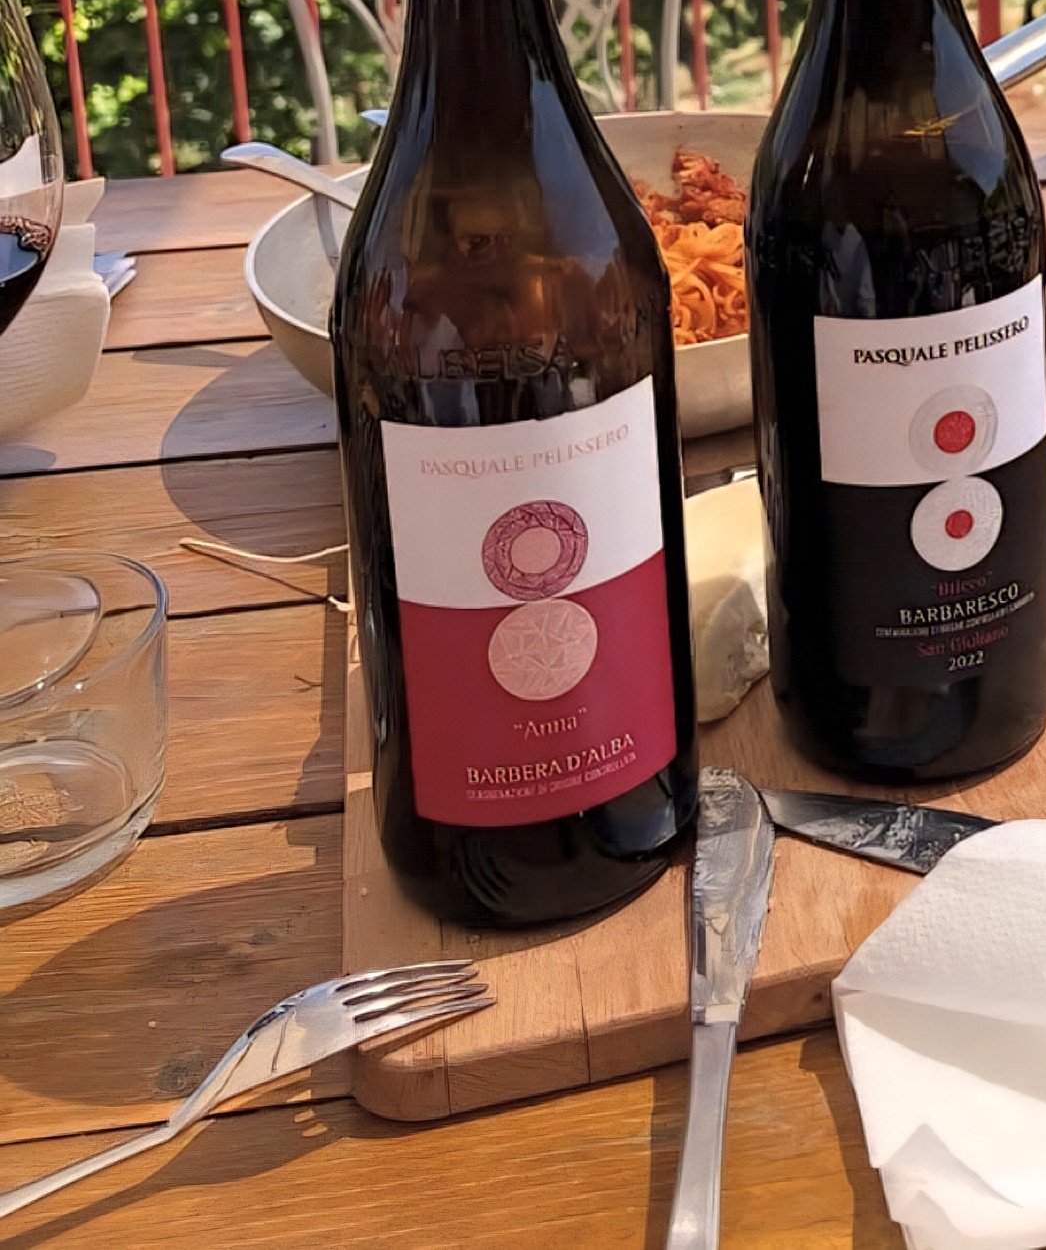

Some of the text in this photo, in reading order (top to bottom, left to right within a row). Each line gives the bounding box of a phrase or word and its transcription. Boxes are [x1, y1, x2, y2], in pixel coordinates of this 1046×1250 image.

[853, 315, 1029, 366] PASQUALE PELISSERO
[419, 424, 629, 478] PASQUALE PELISSERO
[900, 582, 1019, 625] BARBARESCO
[948, 650, 984, 671] 2022
[467, 760, 562, 785] BARBERA
[566, 733, 634, 772] D'ALBA
